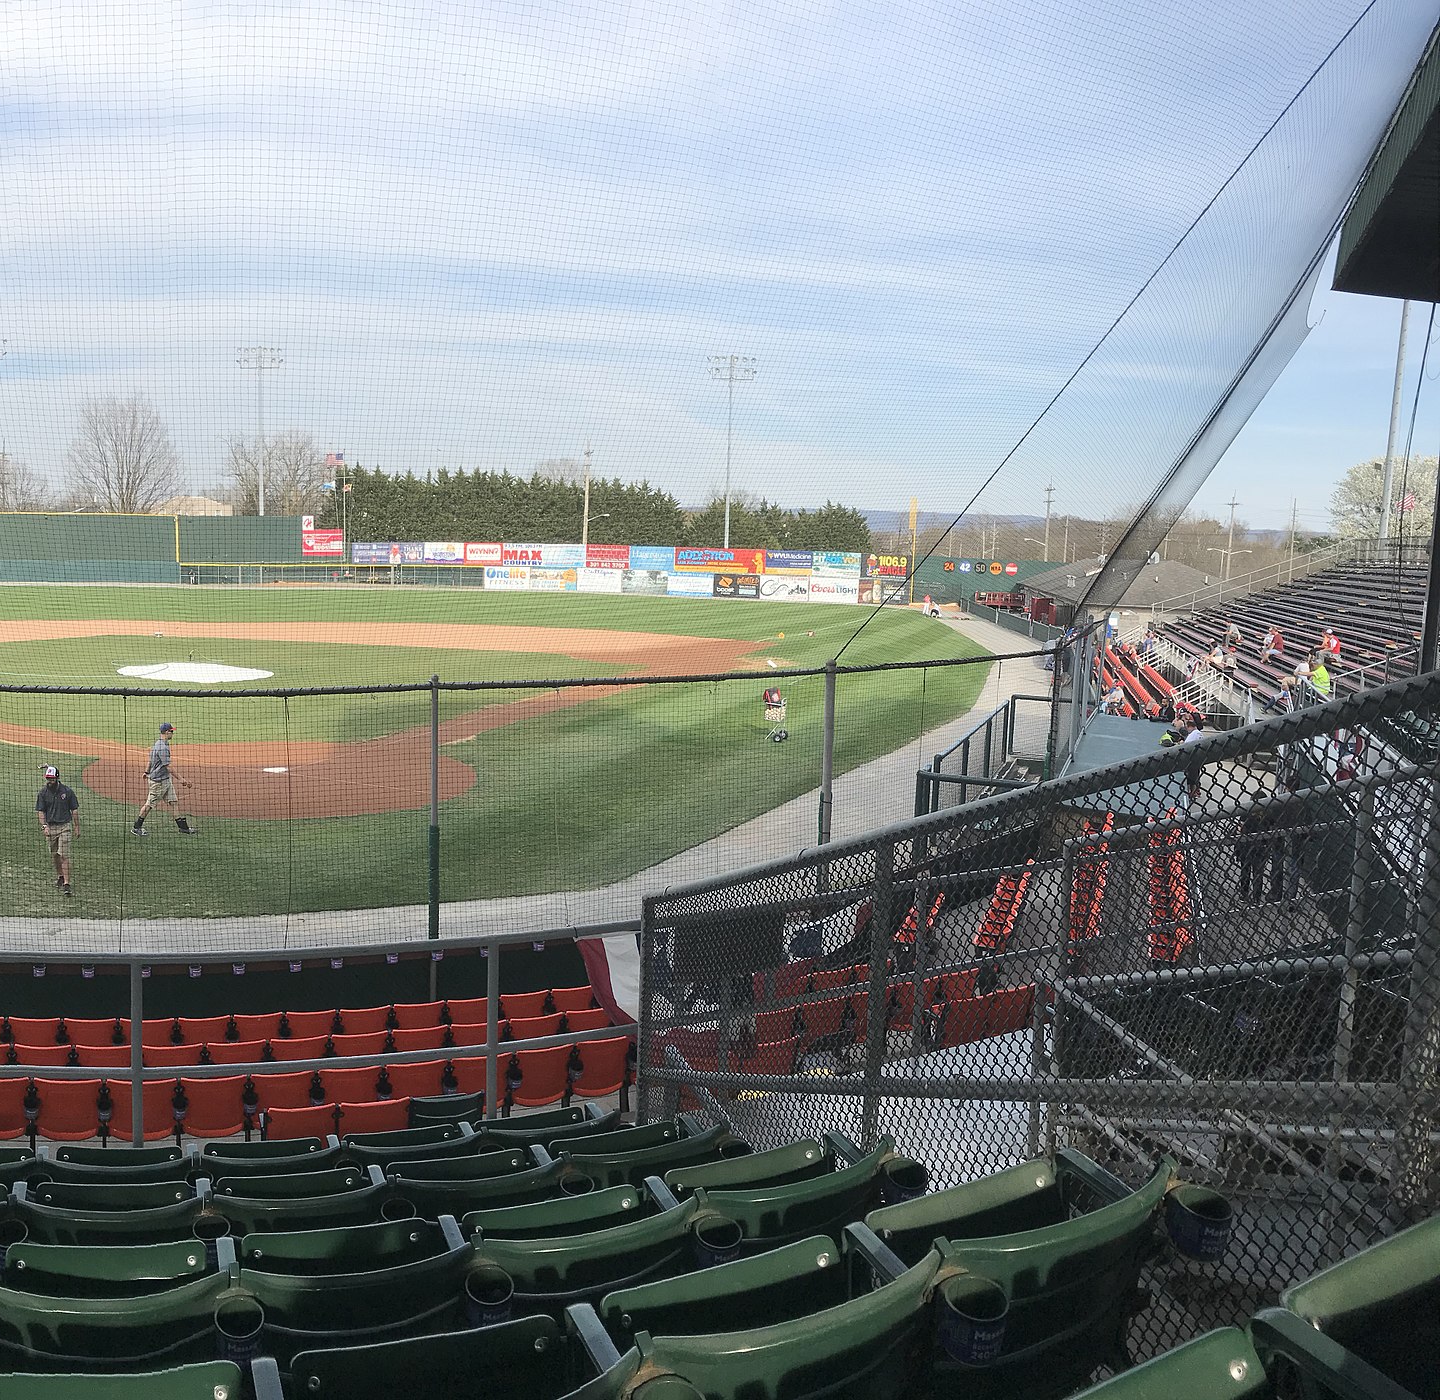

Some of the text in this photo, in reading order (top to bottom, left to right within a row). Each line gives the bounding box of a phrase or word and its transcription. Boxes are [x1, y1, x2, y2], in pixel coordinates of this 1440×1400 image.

[504, 550, 542, 560] MAX
[944, 562, 954, 571] 24
[960, 563, 970, 571] 42
[811, 584, 835, 593] Coors
[836, 584, 857, 594] LIGHT
